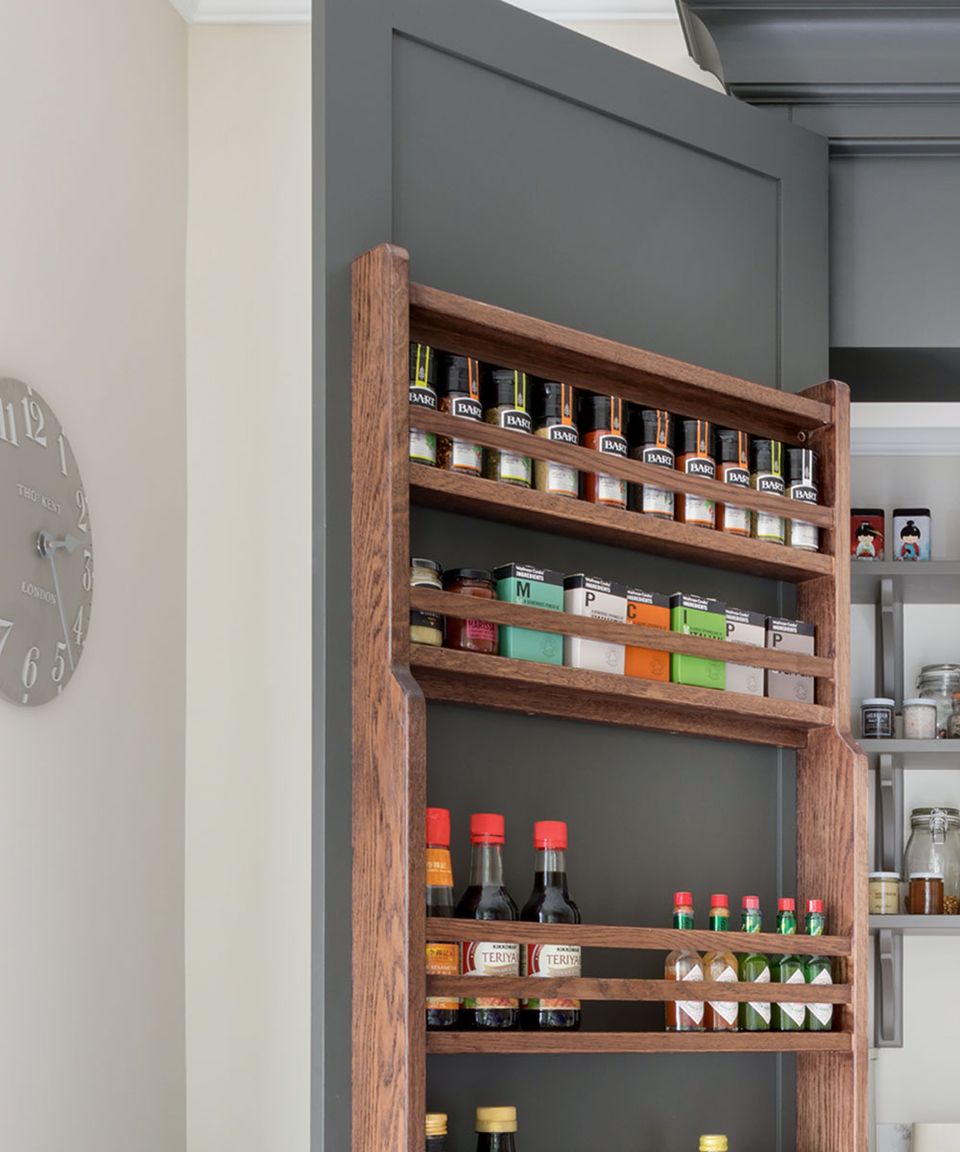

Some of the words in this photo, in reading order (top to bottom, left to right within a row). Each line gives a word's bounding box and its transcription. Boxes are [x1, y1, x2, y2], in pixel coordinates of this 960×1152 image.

[21, 397, 47, 447] 12
[76, 489, 88, 531] 2
[82, 549, 91, 591] 3
[517, 581, 530, 598] M
[585, 592, 595, 607] P
[73, 606, 83, 645] 4
[627, 604, 636, 619] C
[684, 610, 687, 624] I
[726, 623, 735, 637] P
[773, 633, 782, 647] P
[23, 646, 40, 688] 6
[52, 641, 66, 682] 5
